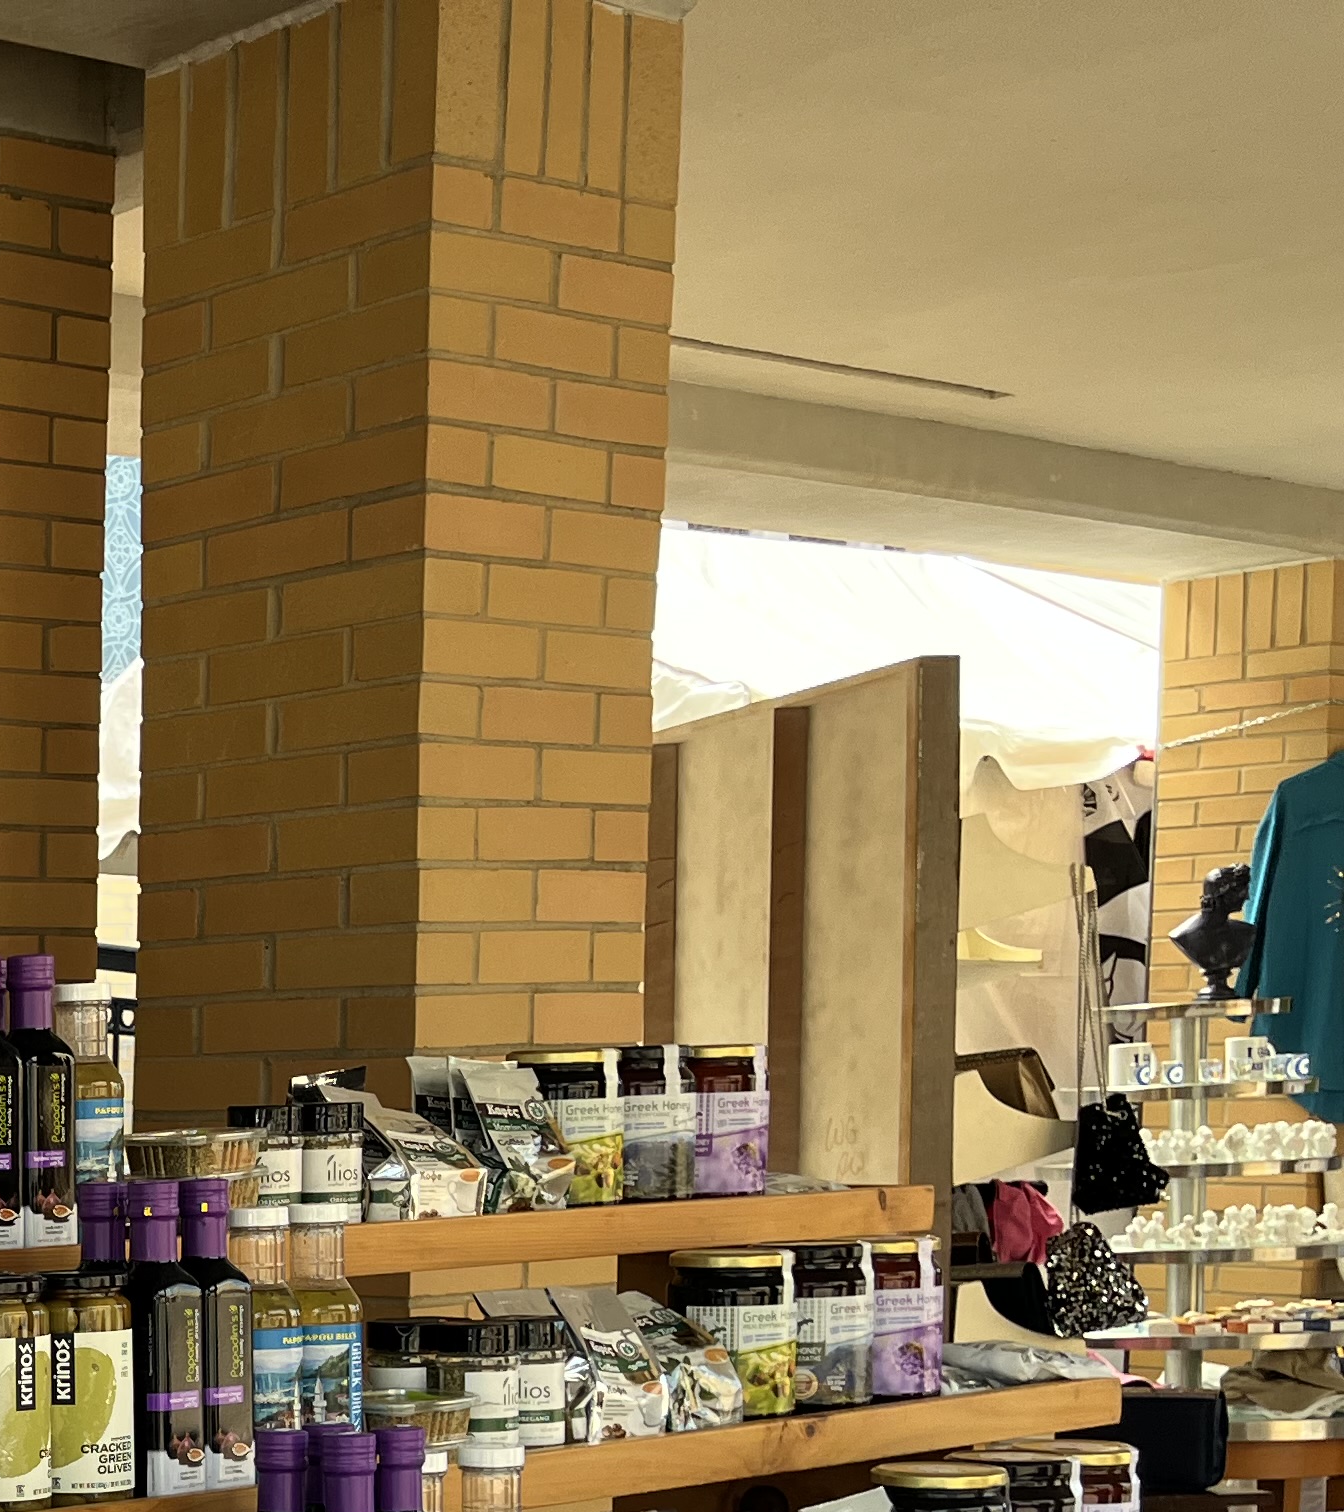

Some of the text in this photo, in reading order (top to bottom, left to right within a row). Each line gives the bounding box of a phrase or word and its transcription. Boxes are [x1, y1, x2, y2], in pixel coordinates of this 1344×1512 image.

[624, 1101, 659, 1113] Greek
[81, 1442, 132, 1454] CRACKED
[98, 1453, 132, 1464] GREEN
[97, 1462, 132, 1475] OLIVES
